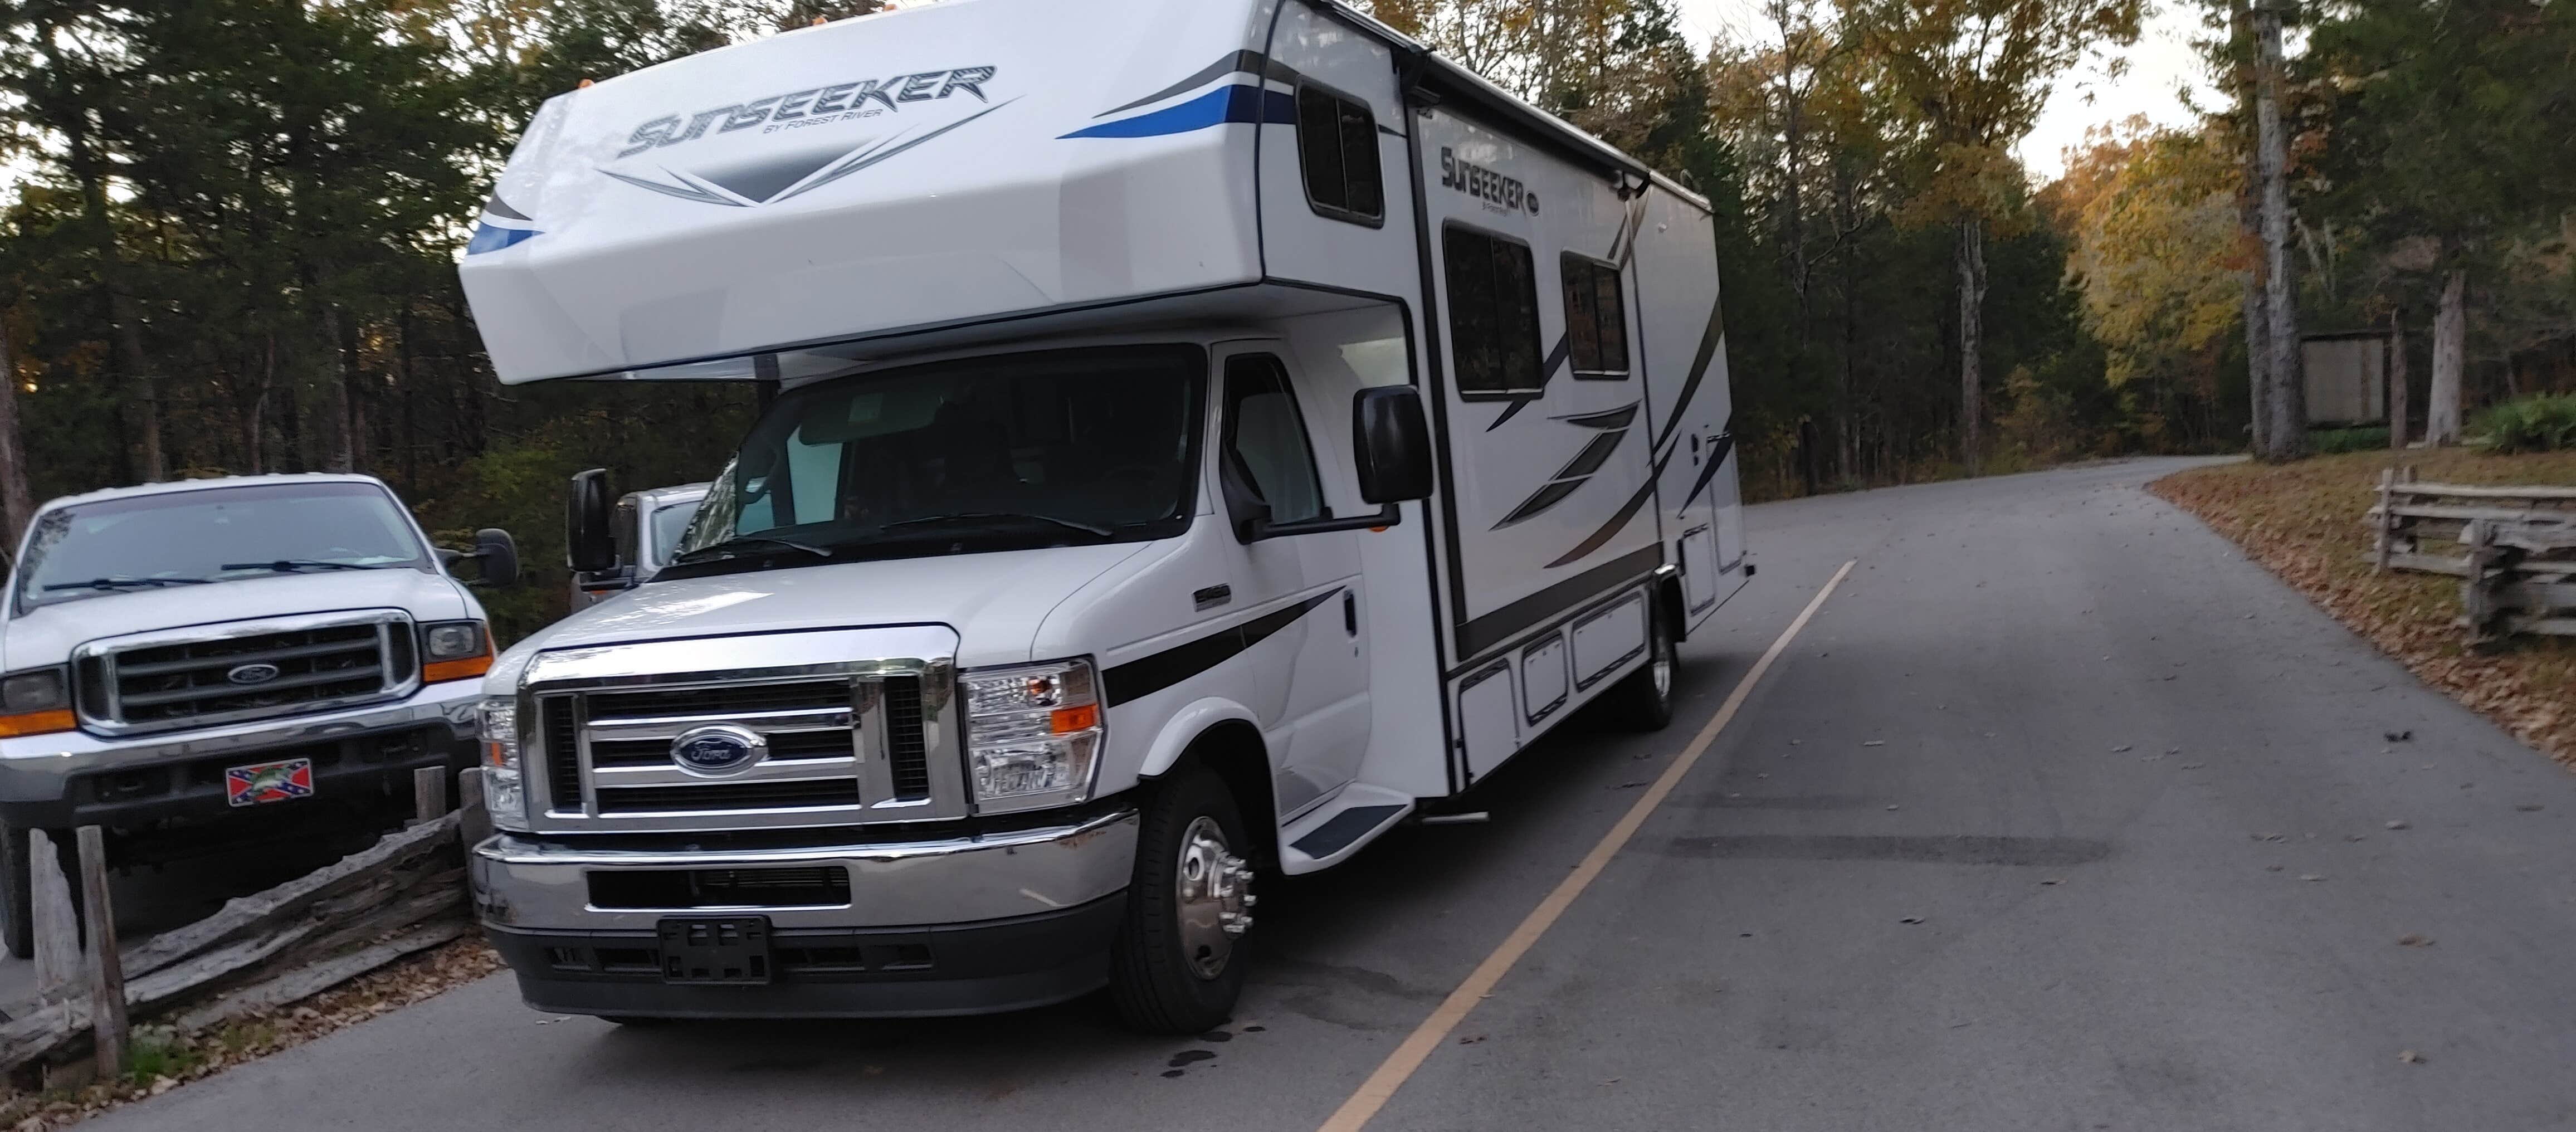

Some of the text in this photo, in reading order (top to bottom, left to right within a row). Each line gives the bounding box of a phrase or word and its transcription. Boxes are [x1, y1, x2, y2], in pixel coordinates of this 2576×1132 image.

[617, 65, 997, 159] SUNSEEKER
[763, 109, 883, 134] BY FOREST RIVER
[1441, 147, 1526, 218] SUNSEEKER
[690, 740, 732, 761] Ford
